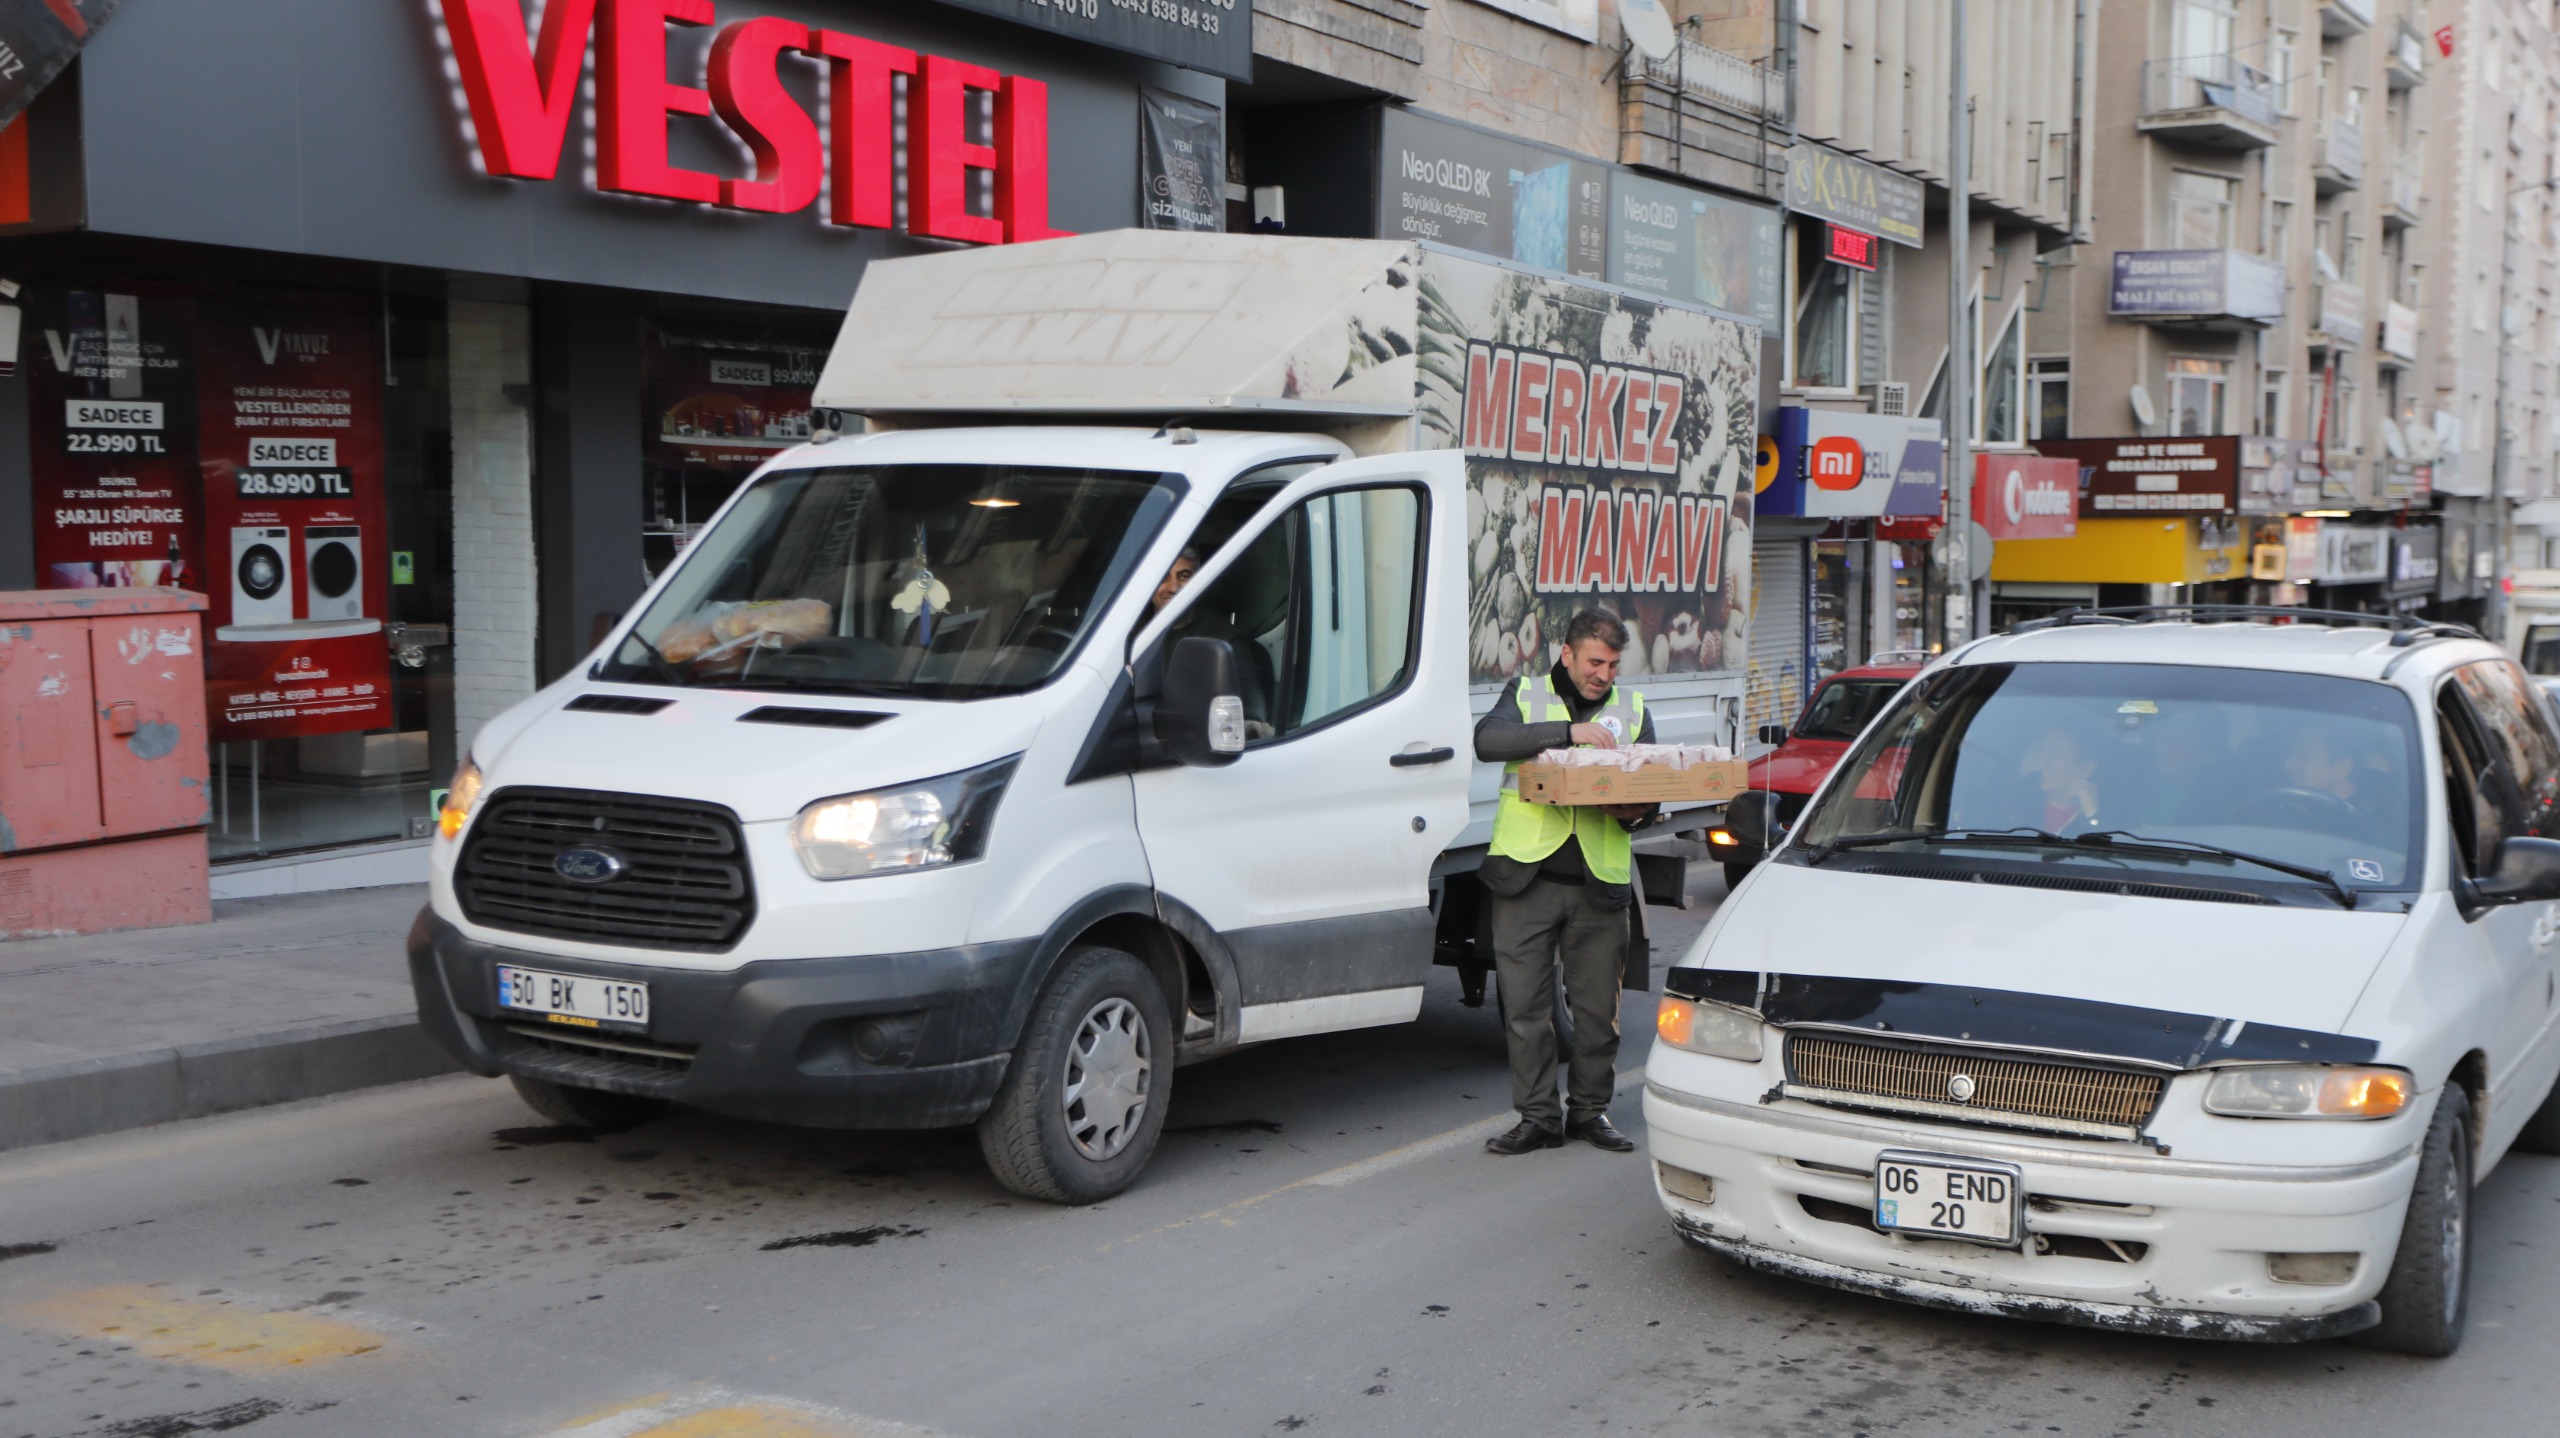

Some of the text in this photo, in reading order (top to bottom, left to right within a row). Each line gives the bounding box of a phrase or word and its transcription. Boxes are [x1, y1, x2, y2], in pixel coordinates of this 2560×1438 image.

[1151, 0, 1178, 23] 638
[1181, 7, 1199, 29] 84
[1202, 13, 1219, 35] 33
[438, 0, 1084, 244] VESTEL
[1164, 155, 1203, 184] OPEL
[1402, 150, 1492, 199] Neo QLED 8K
[1813, 151, 1877, 211] KAYA
[1153, 175, 1213, 208] CORSA
[1402, 192, 1443, 216] Büyüklük
[1152, 201, 1214, 227] SİZİN OLSUN!
[1624, 194, 1648, 223] Neo
[1649, 202, 1678, 230] QLED
[79, 407, 153, 425] SADECE
[1464, 341, 1686, 475] MERKEZ
[67, 433, 167, 453] 22.990 TL
[254, 444, 330, 462] SADECE
[238, 473, 351, 495] 28.990 TL
[111, 505, 184, 524] SÜPÜRGE
[89, 527, 153, 547] HEDİYE!
[1535, 486, 1728, 594] MANAVI
[563, 855, 600, 876] Ford
[513, 972, 645, 1019] 50 BK 150
[1885, 1166, 2006, 1204] 06 END
[1930, 1201, 1966, 1230] 20
